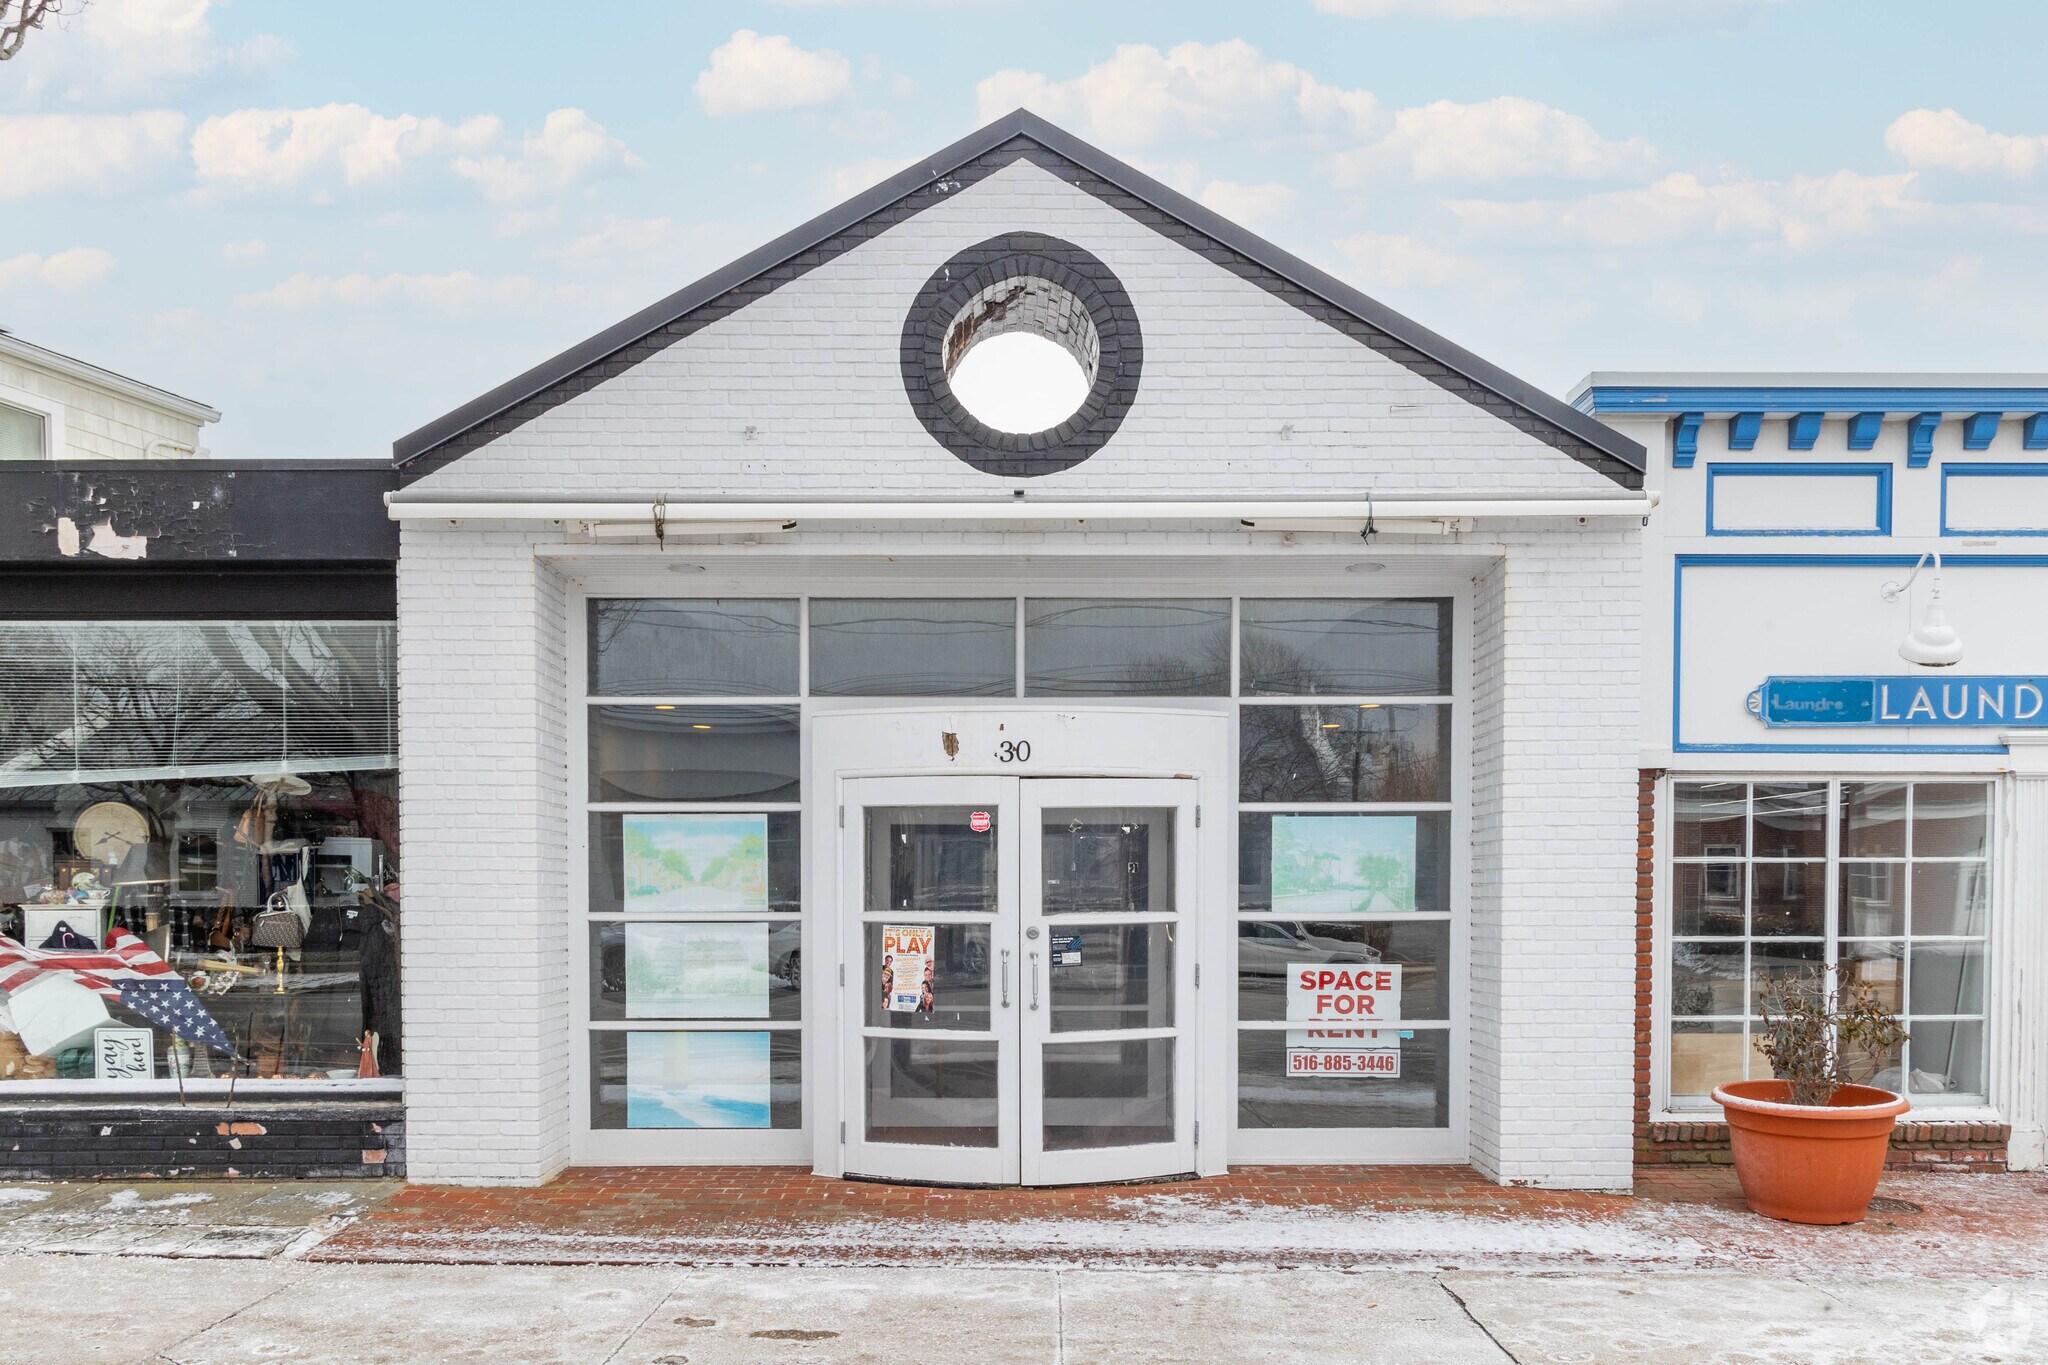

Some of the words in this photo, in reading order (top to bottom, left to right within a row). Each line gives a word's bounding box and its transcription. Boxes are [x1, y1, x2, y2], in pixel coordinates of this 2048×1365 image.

[999, 740, 1031, 762] 30
[902, 929, 925, 937] ONLY
[926, 929, 933, 938] A
[884, 936, 932, 954] PLAY
[1299, 970, 1392, 991] SPACE
[1316, 994, 1375, 1015] FOR
[103, 1034, 133, 1079] yay
[124, 1037, 147, 1072] here!
[1293, 1054, 1395, 1072] 516-885-3446
